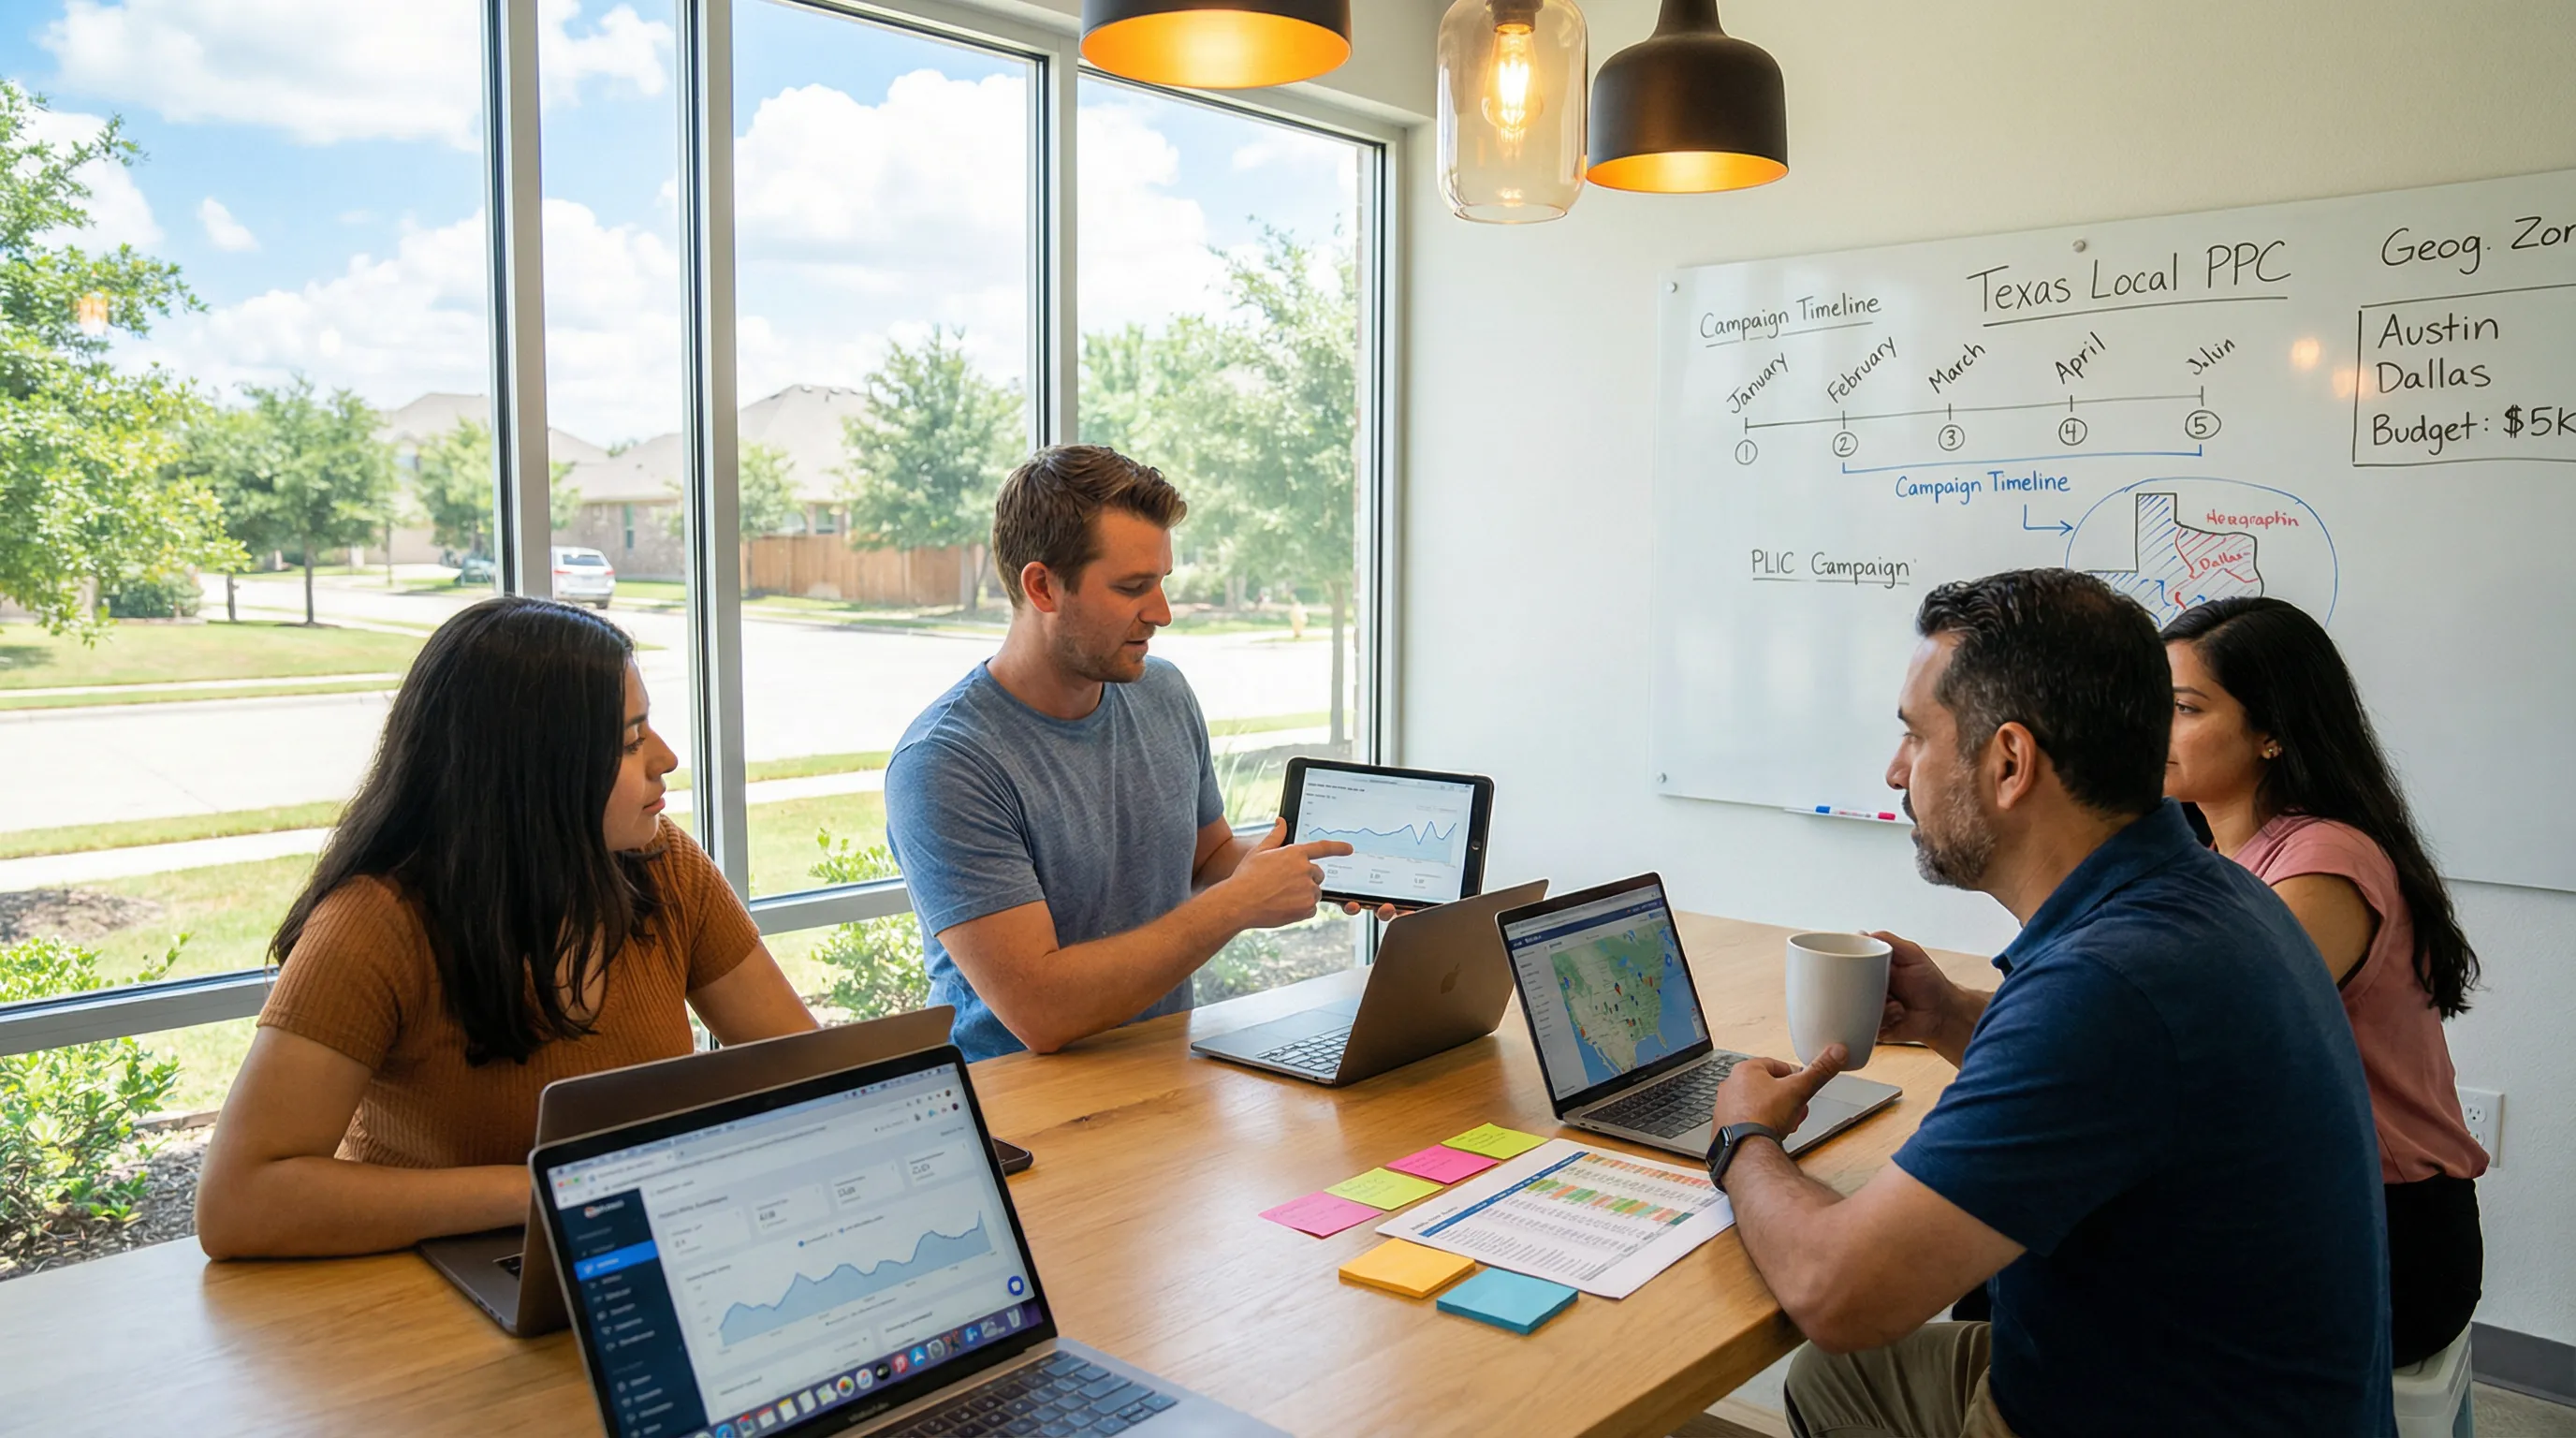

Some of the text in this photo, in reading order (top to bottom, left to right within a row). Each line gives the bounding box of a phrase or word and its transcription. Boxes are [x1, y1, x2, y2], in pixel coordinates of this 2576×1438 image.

[2380, 227, 2492, 275] Geog.
[1966, 240, 2291, 313] Texas Local PPC
[1700, 292, 1882, 339] Campaign Timeline
[2377, 312, 2499, 349] Austin
[1827, 336, 1897, 404] February
[1928, 345, 1986, 395] March
[2055, 330, 2106, 383] April
[2375, 357, 2492, 394] Dallas
[1726, 352, 1790, 415] January
[2372, 404, 2576, 456] Budget: $5K
[1895, 469, 2071, 506] Campaign Timeline
[1751, 549, 1795, 575] PLIC
